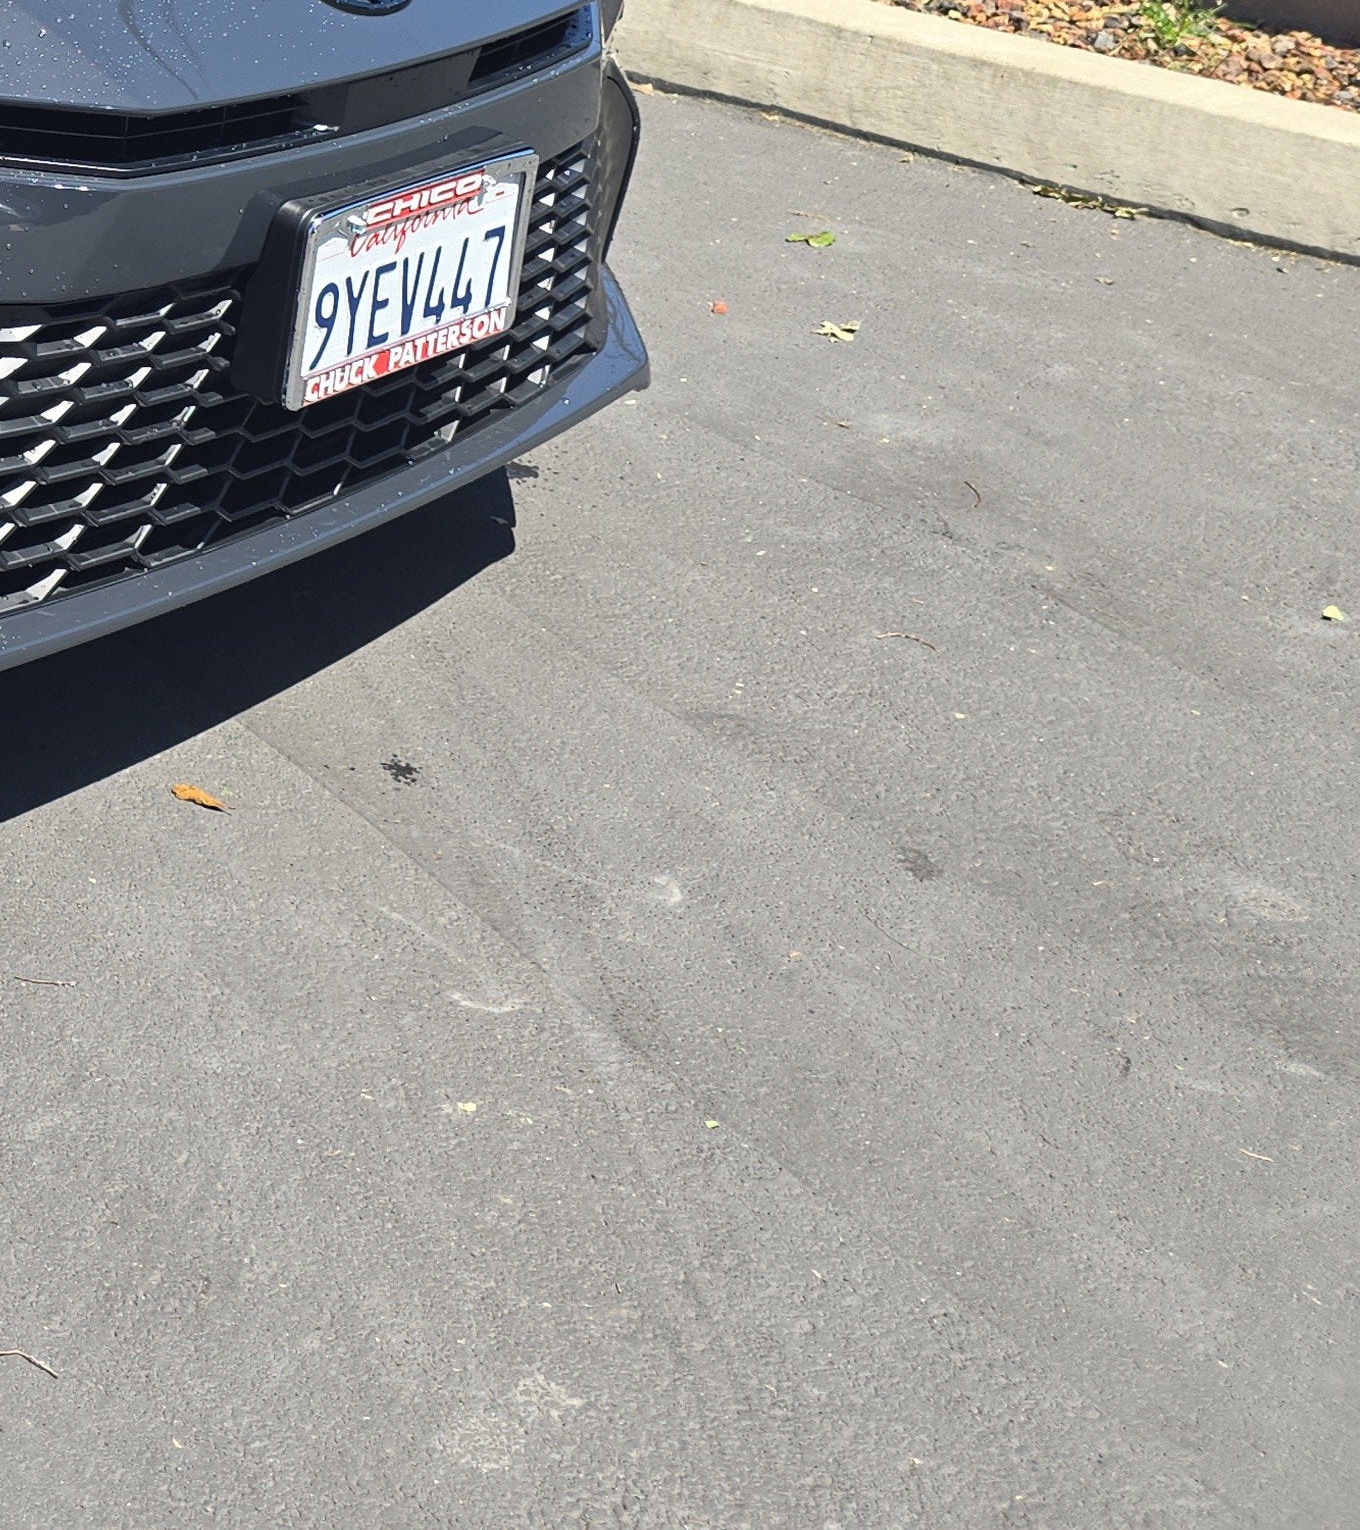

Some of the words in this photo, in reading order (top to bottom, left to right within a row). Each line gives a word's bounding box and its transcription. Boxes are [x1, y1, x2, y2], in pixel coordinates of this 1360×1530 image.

[365, 175, 483, 227] CHICO
[309, 225, 507, 371] 9YEV447
[304, 354, 382, 402] CHUCK
[386, 306, 507, 371] PATTERSON
